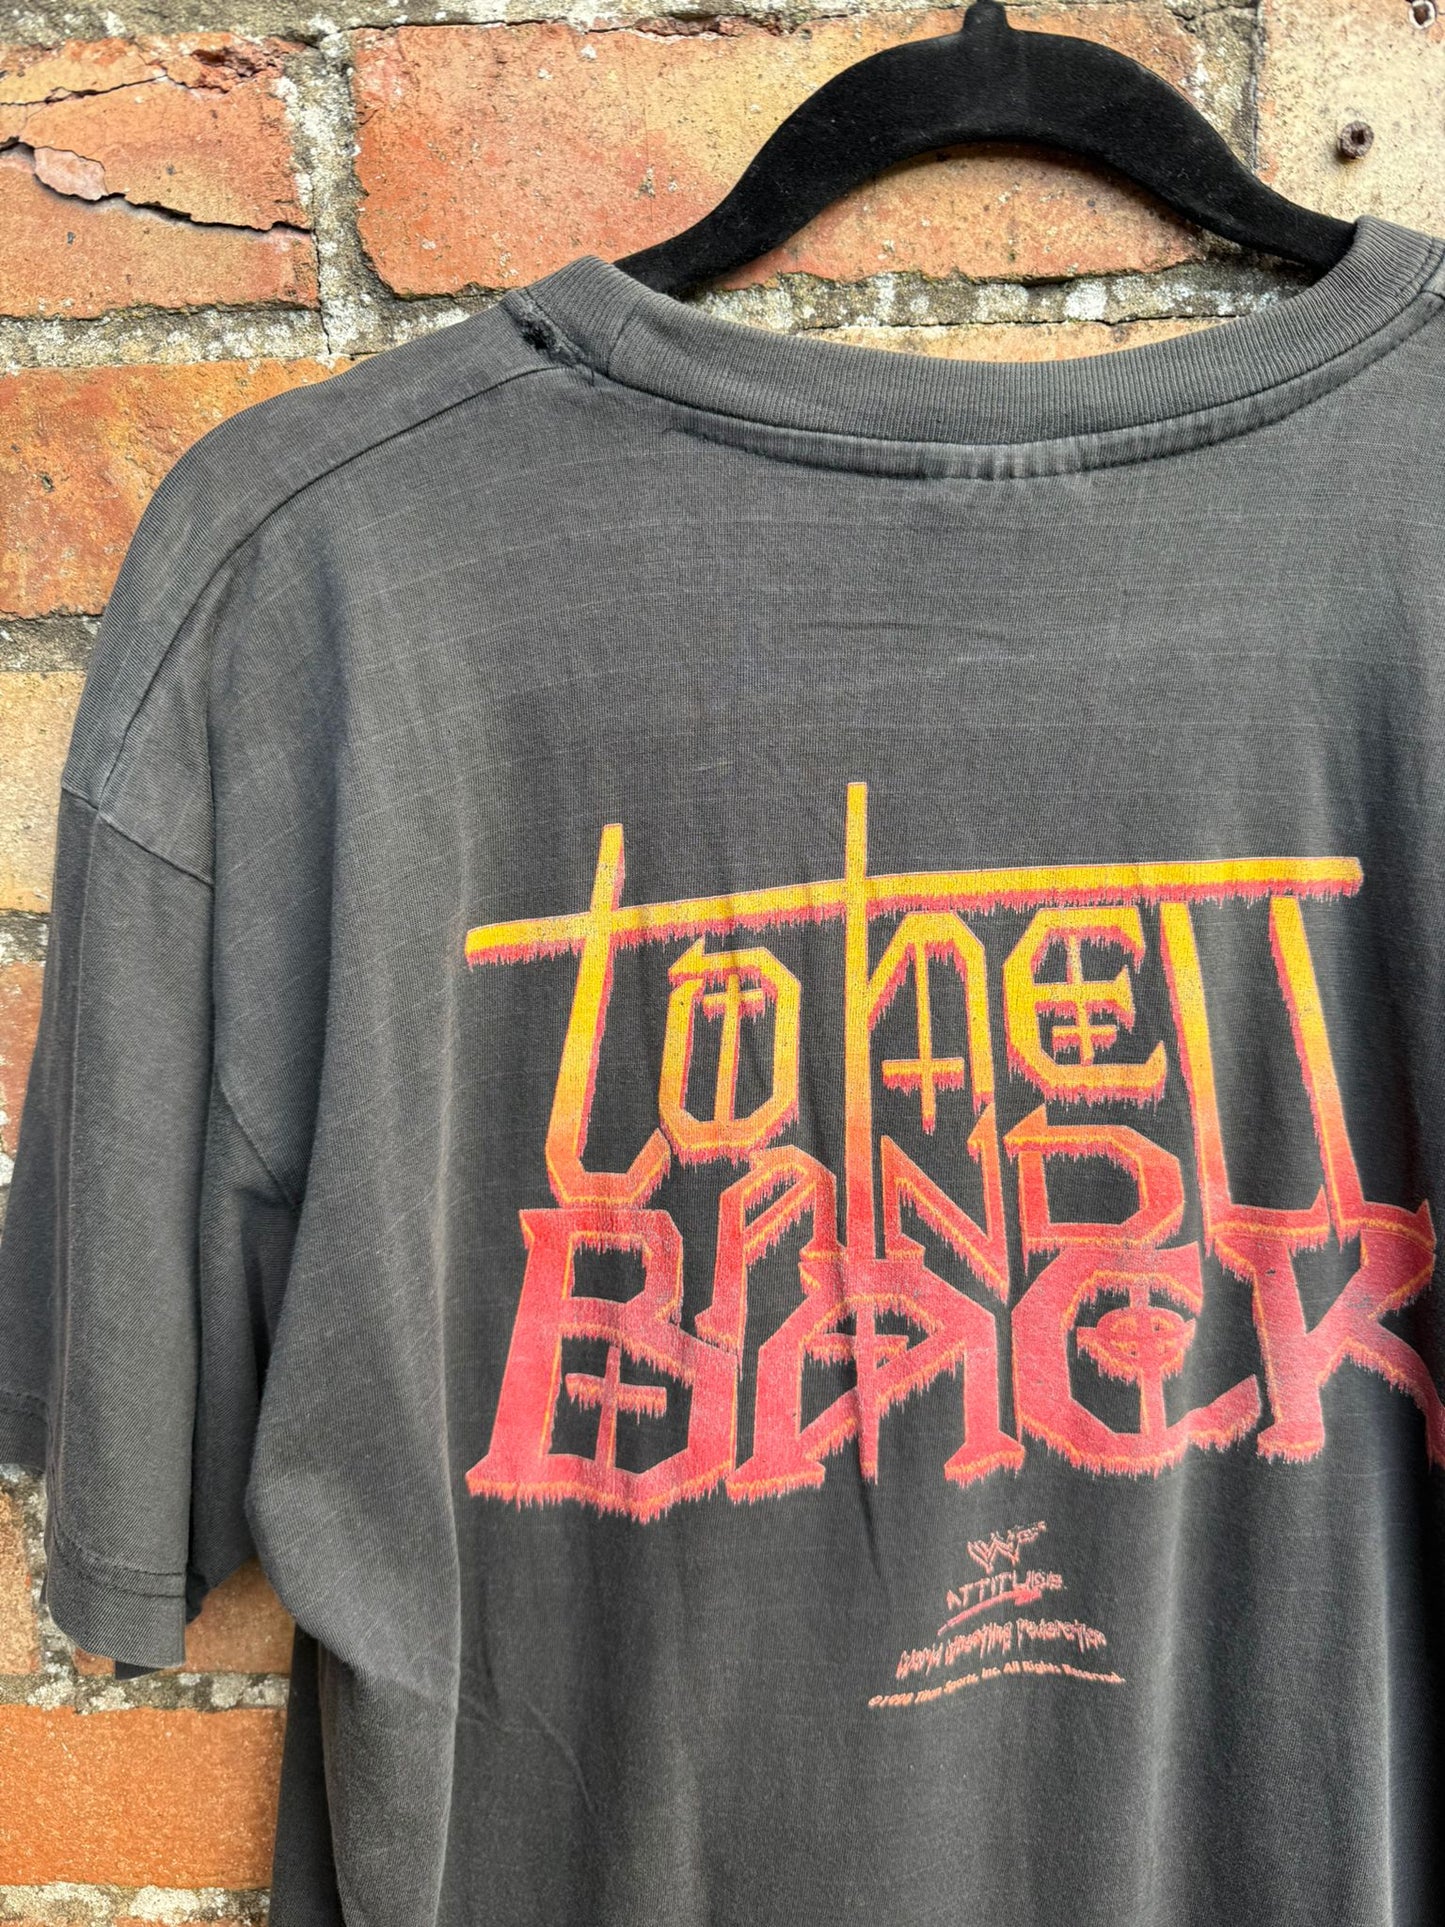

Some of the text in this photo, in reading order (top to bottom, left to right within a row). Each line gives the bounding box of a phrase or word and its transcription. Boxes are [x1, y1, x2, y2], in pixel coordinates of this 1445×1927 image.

[465, 1206, 1445, 1524] BACK
[1002, 1659, 1021, 1675] All
[1021, 1660, 1061, 1676] Rights
